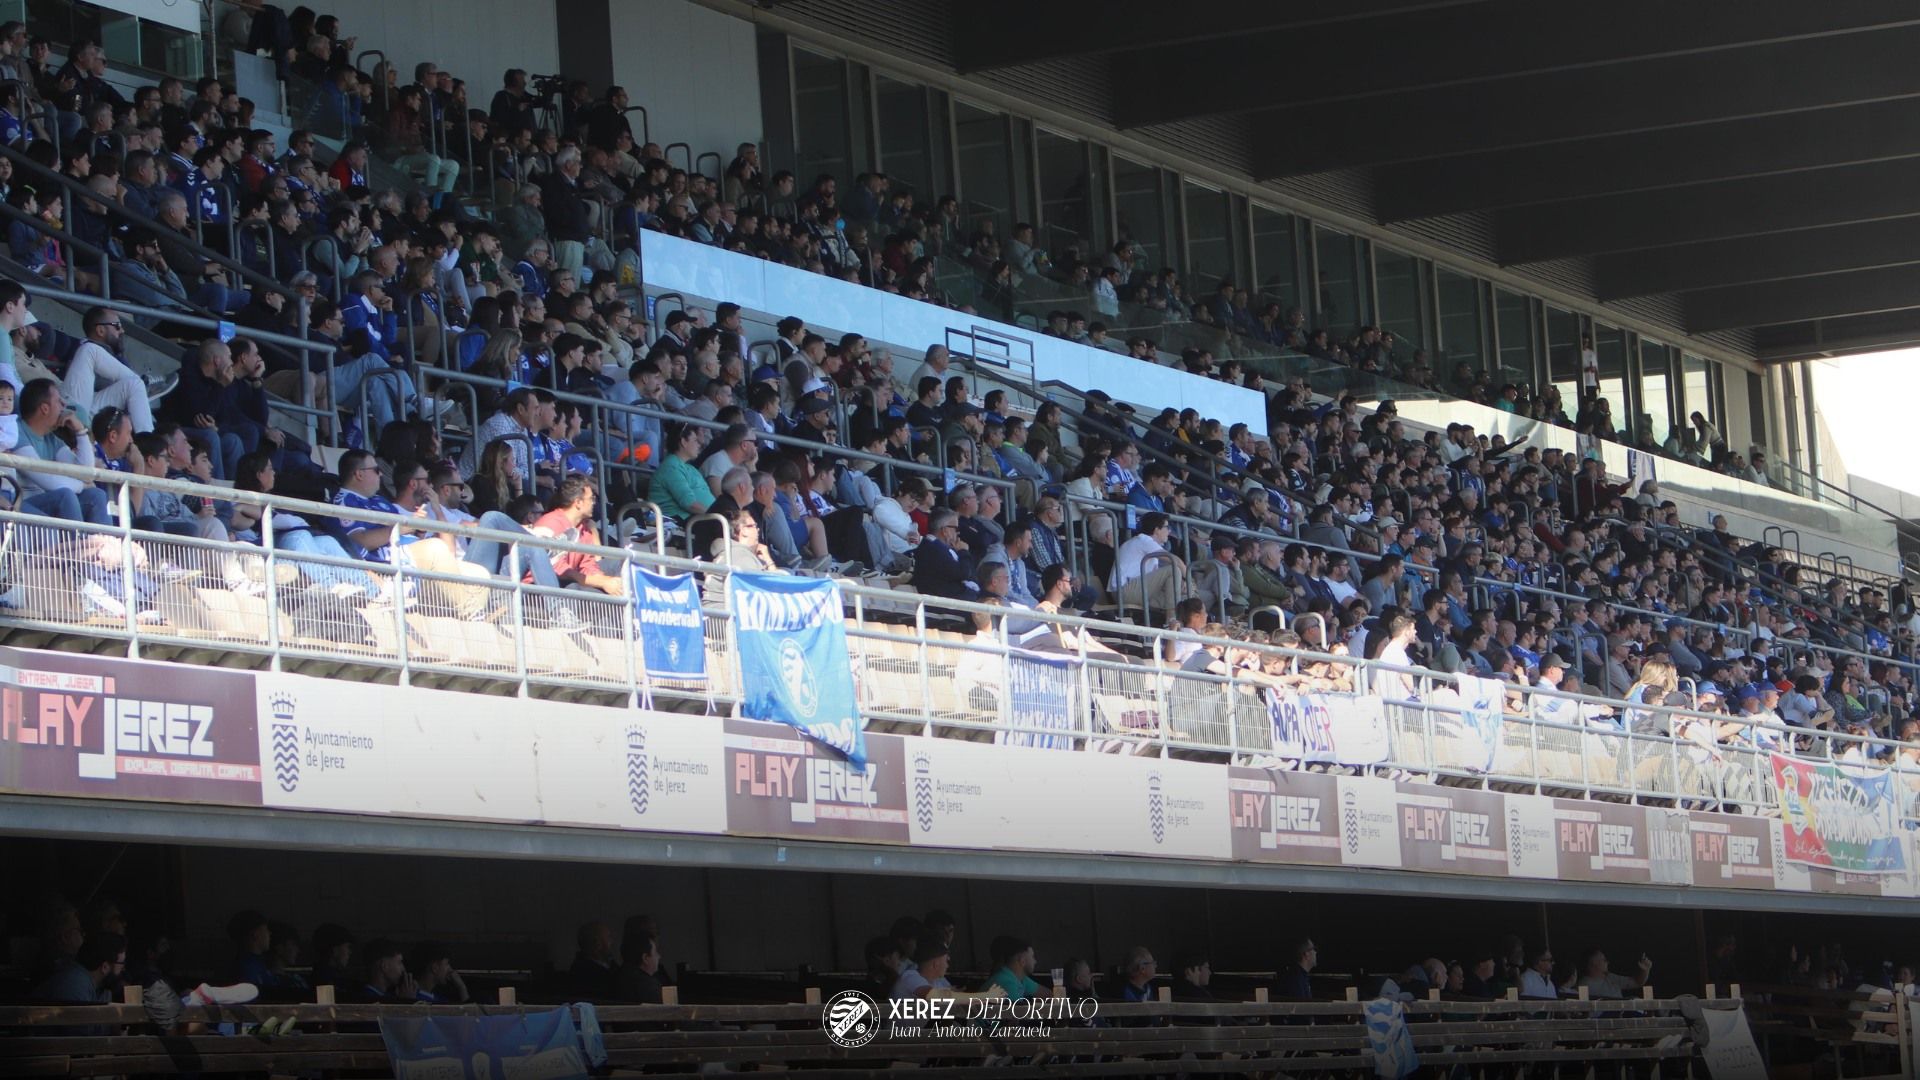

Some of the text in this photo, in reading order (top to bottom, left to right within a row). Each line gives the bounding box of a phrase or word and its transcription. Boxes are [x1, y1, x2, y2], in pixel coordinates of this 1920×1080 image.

[304, 726, 374, 751] Ayuntamiento
[306, 750, 346, 771] de Jerez
[652, 756, 709, 776] Ayuntamiento
[654, 778, 686, 795] de Jerez
[735, 752, 800, 798] PLAY
[936, 779, 982, 797] Ayuntamiento
[1260, 781, 1321, 848] JEREZ
[1404, 807, 1447, 841] PLAY
[1441, 799, 1490, 861] JEREZ
[1561, 822, 1595, 853] PLAY
[1590, 813, 1635, 870] JEREZ
[1695, 832, 1726, 862] PLAY
